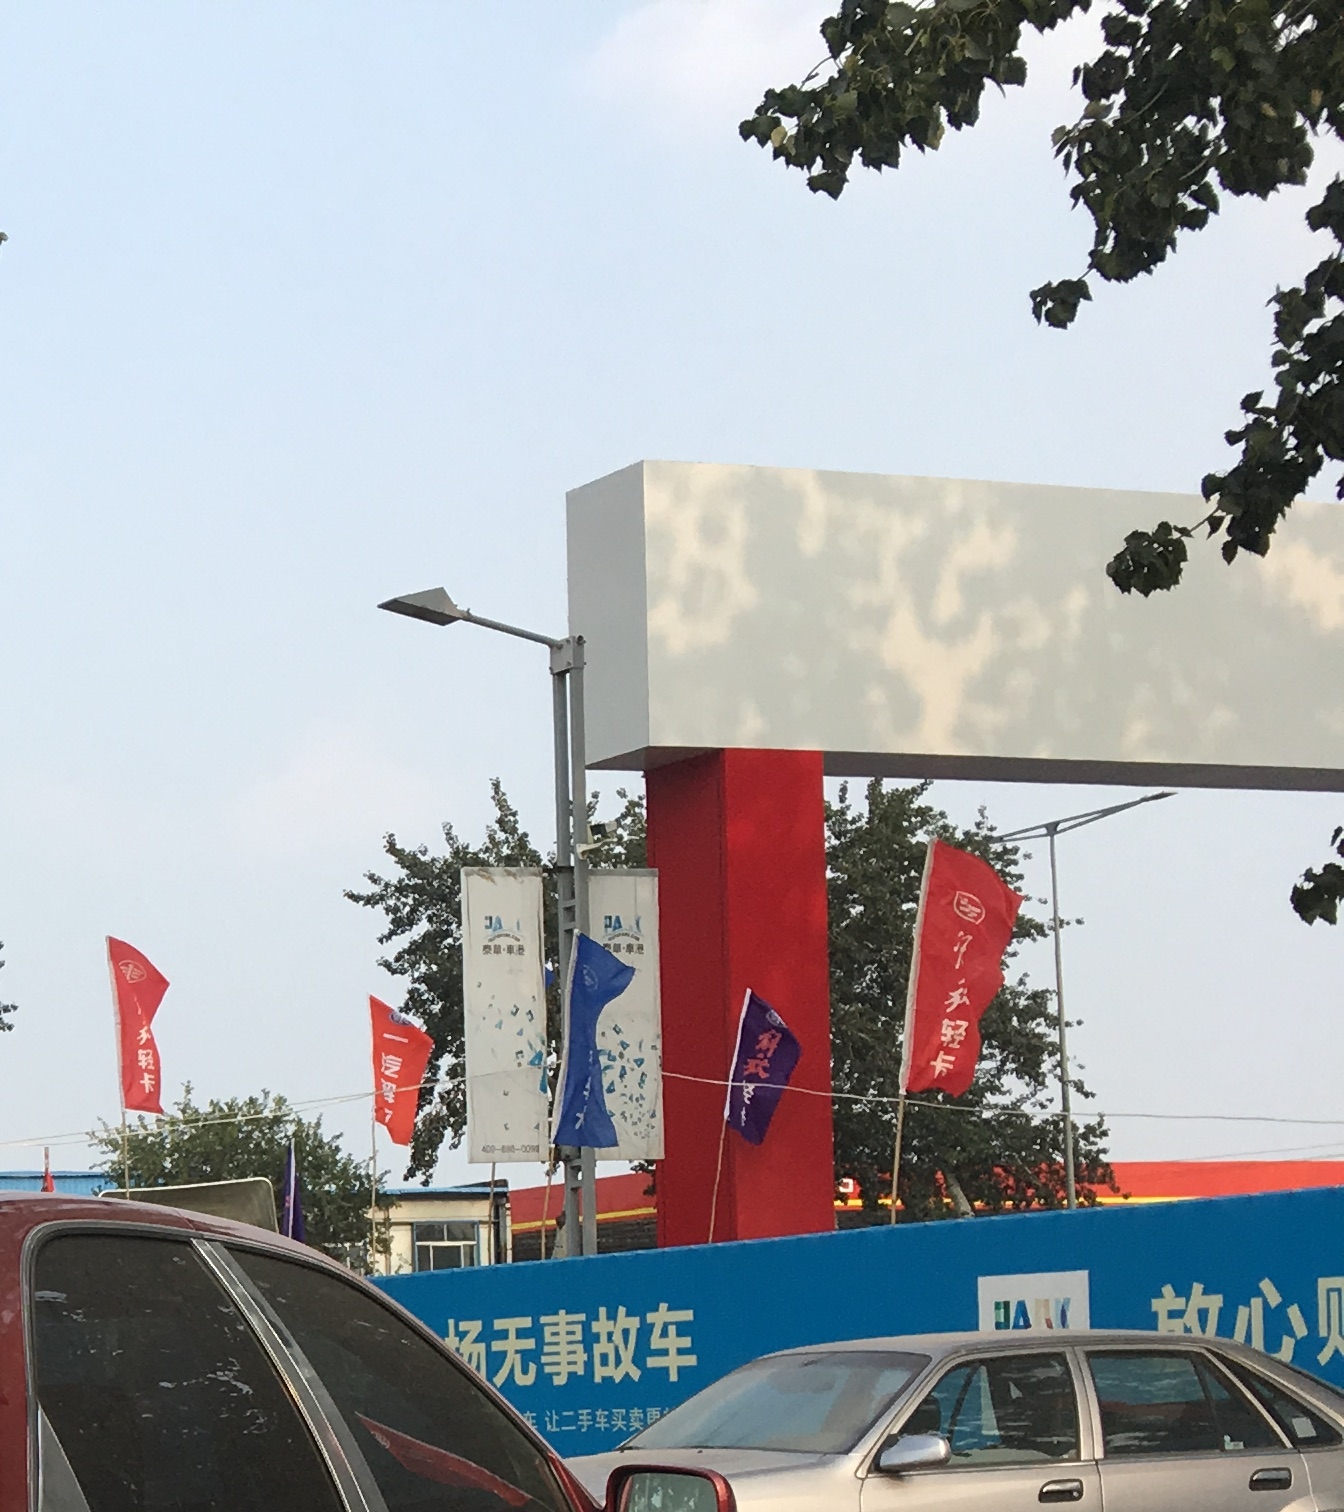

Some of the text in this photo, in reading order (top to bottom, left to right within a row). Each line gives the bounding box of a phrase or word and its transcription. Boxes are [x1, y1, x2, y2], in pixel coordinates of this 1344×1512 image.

[604, 915, 642, 934] PAK
[544, 1406, 674, 1433] 让二手车买卖更
